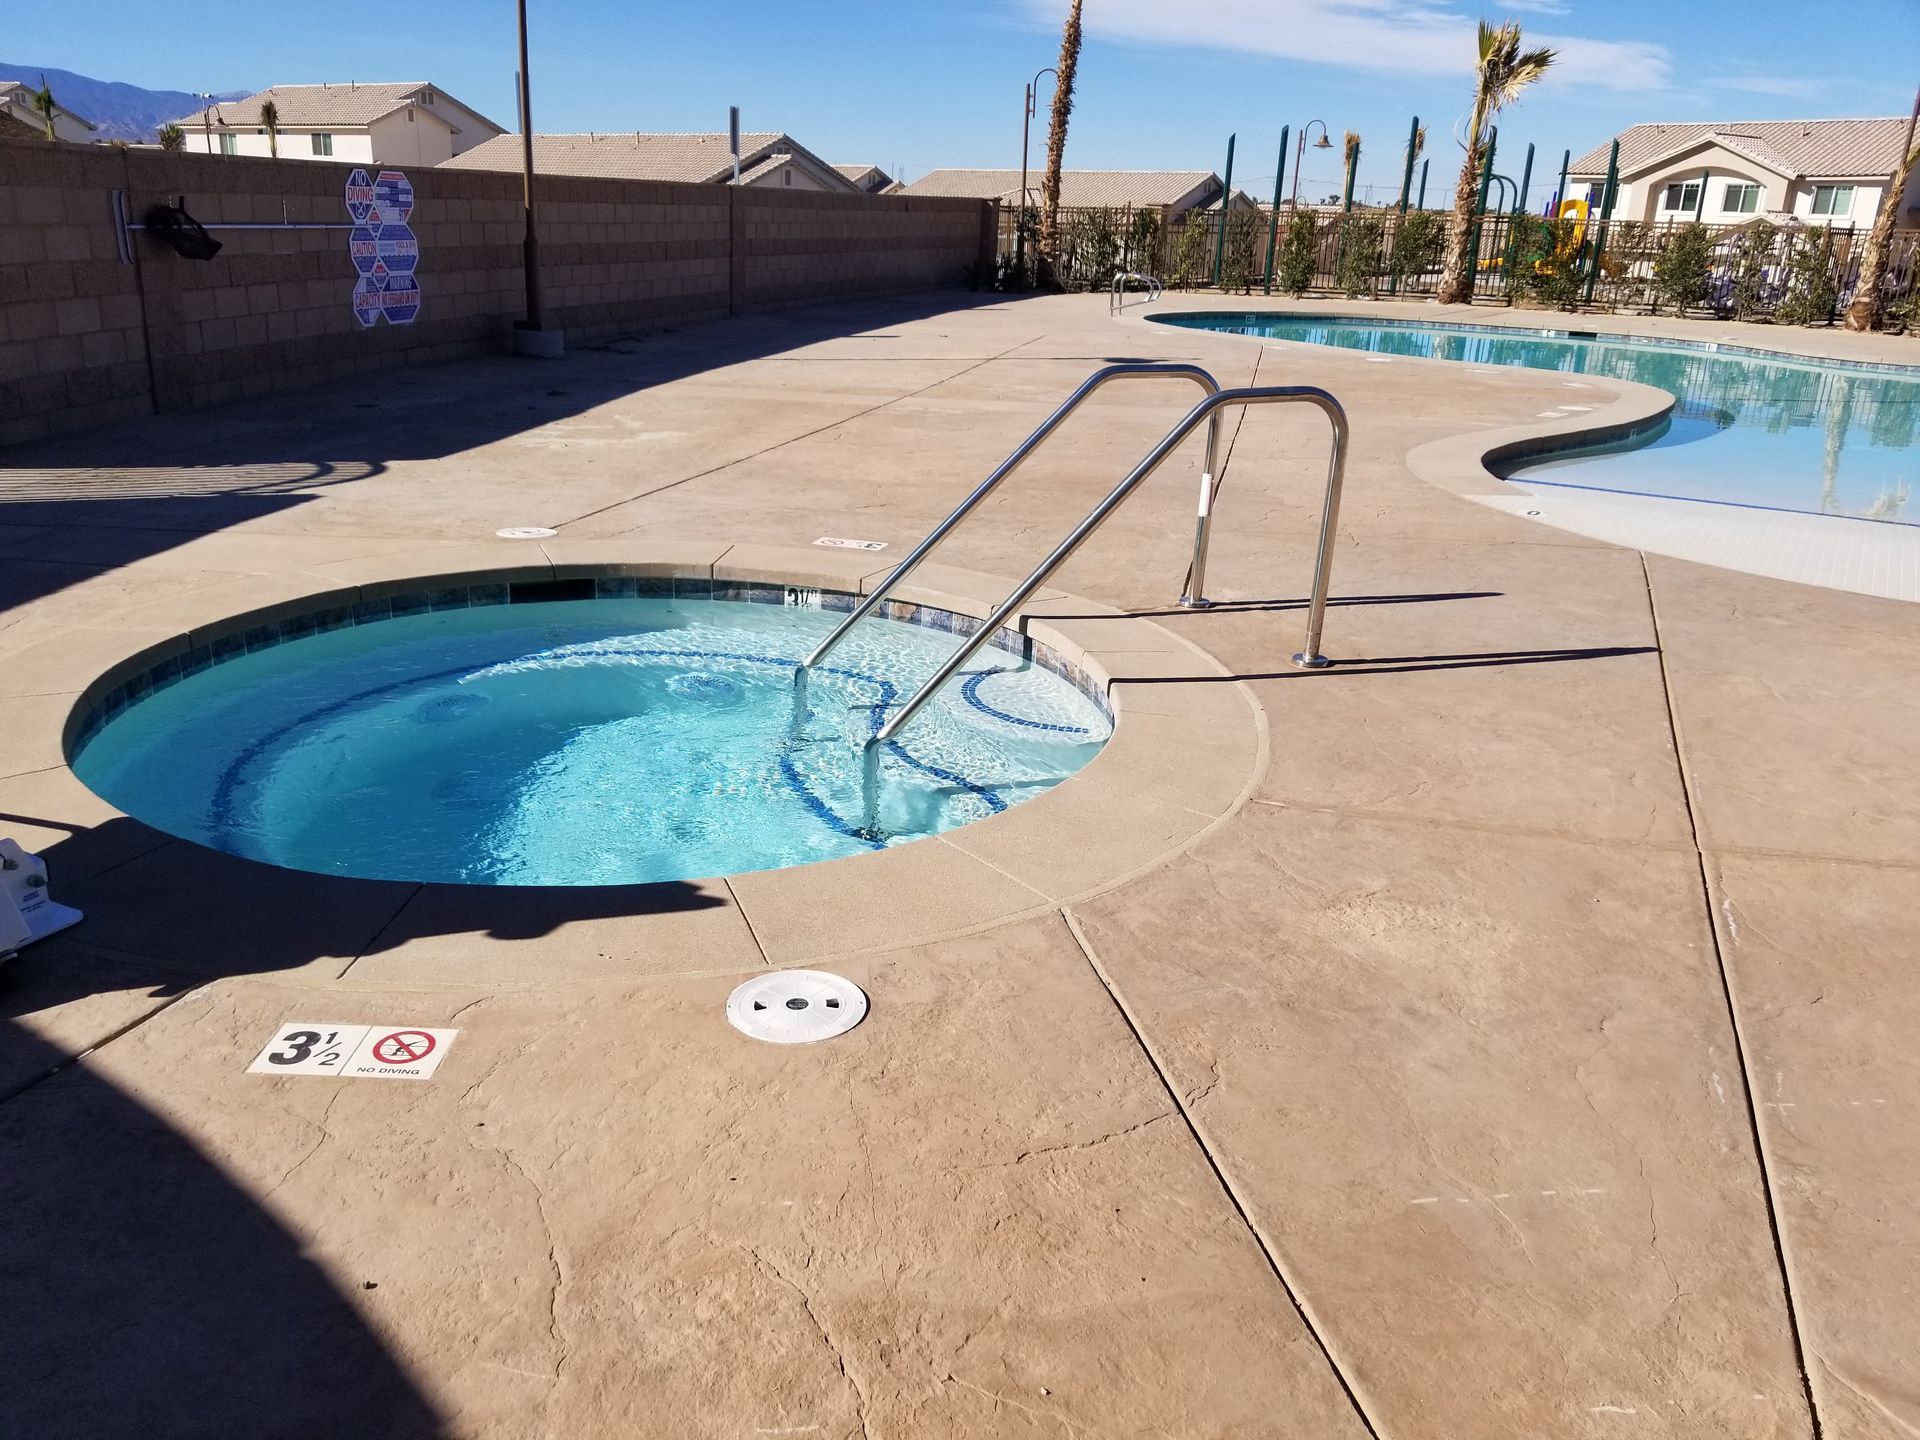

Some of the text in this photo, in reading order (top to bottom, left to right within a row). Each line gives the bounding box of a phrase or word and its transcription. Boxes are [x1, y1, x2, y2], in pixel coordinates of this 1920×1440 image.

[355, 171, 366, 186] NO
[348, 187, 373, 201] DIVING
[351, 241, 377, 256] CAUTION
[390, 276, 412, 290] WARNING
[354, 292, 380, 309] CAPACITY
[378, 1067, 420, 1075] DIVING
